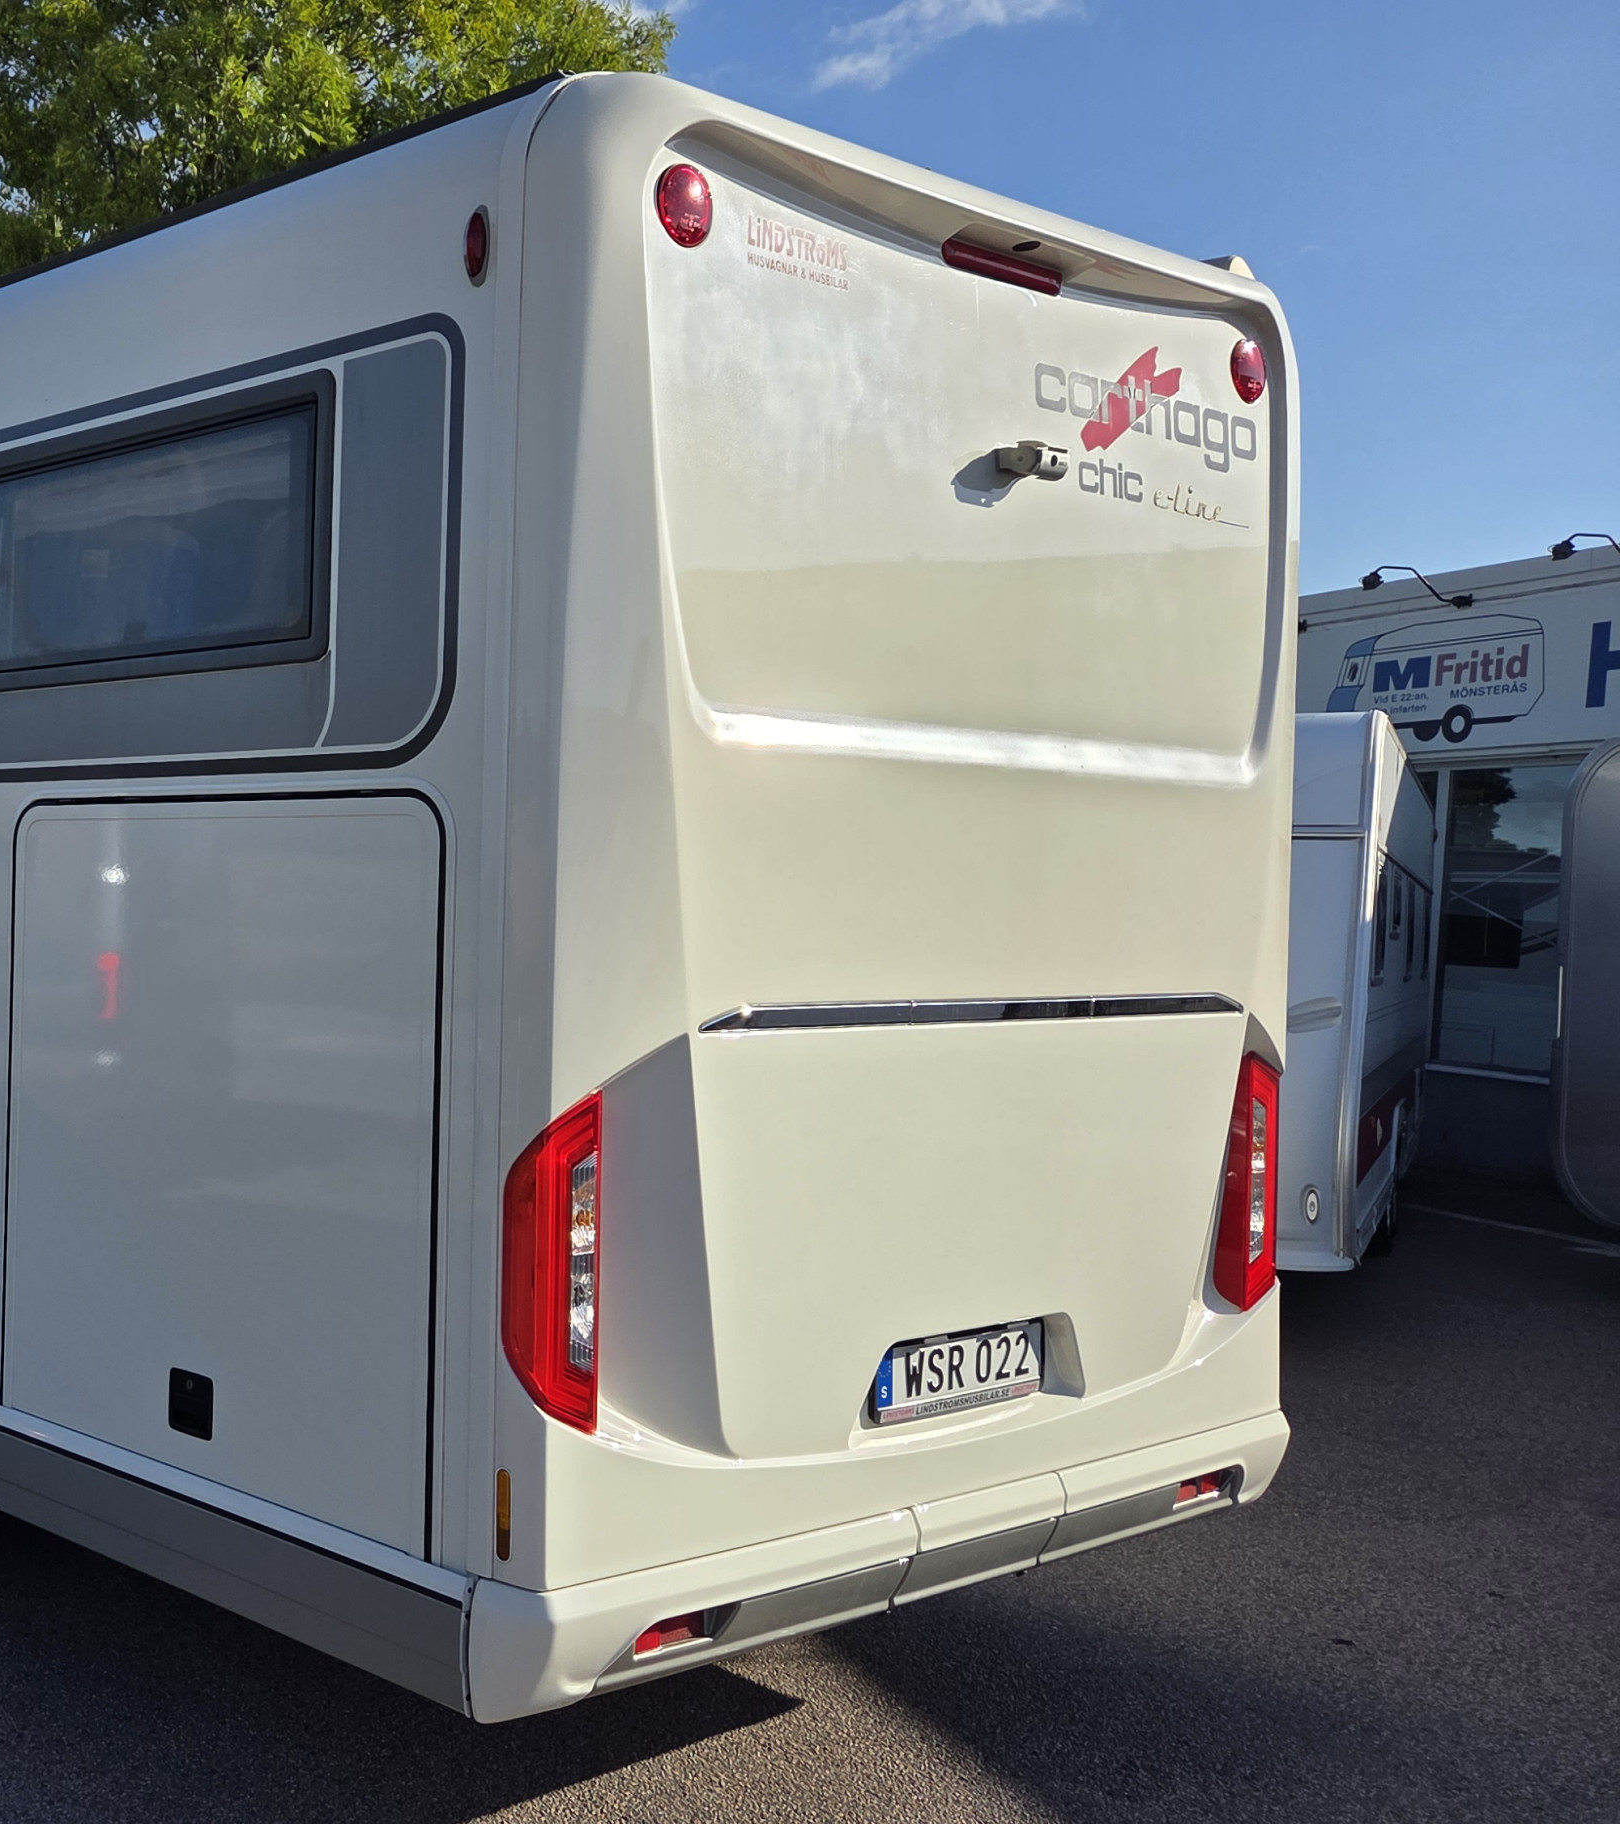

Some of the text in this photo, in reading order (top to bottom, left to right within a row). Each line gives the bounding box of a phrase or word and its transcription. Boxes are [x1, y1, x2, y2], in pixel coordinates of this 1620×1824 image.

[747, 252, 849, 291] HUSVAGNAR & HUSBILAR
[1034, 362, 1257, 473] carthago
[1078, 458, 1144, 503] chic
[1373, 694, 1390, 705] Vid
[1391, 693, 1398, 703] E
[1450, 681, 1528, 699] MÖNSTERÅS
[1389, 703, 1427, 715] infarten
[904, 1334, 1030, 1399] WSR 022
[880, 1385, 888, 1399] S
